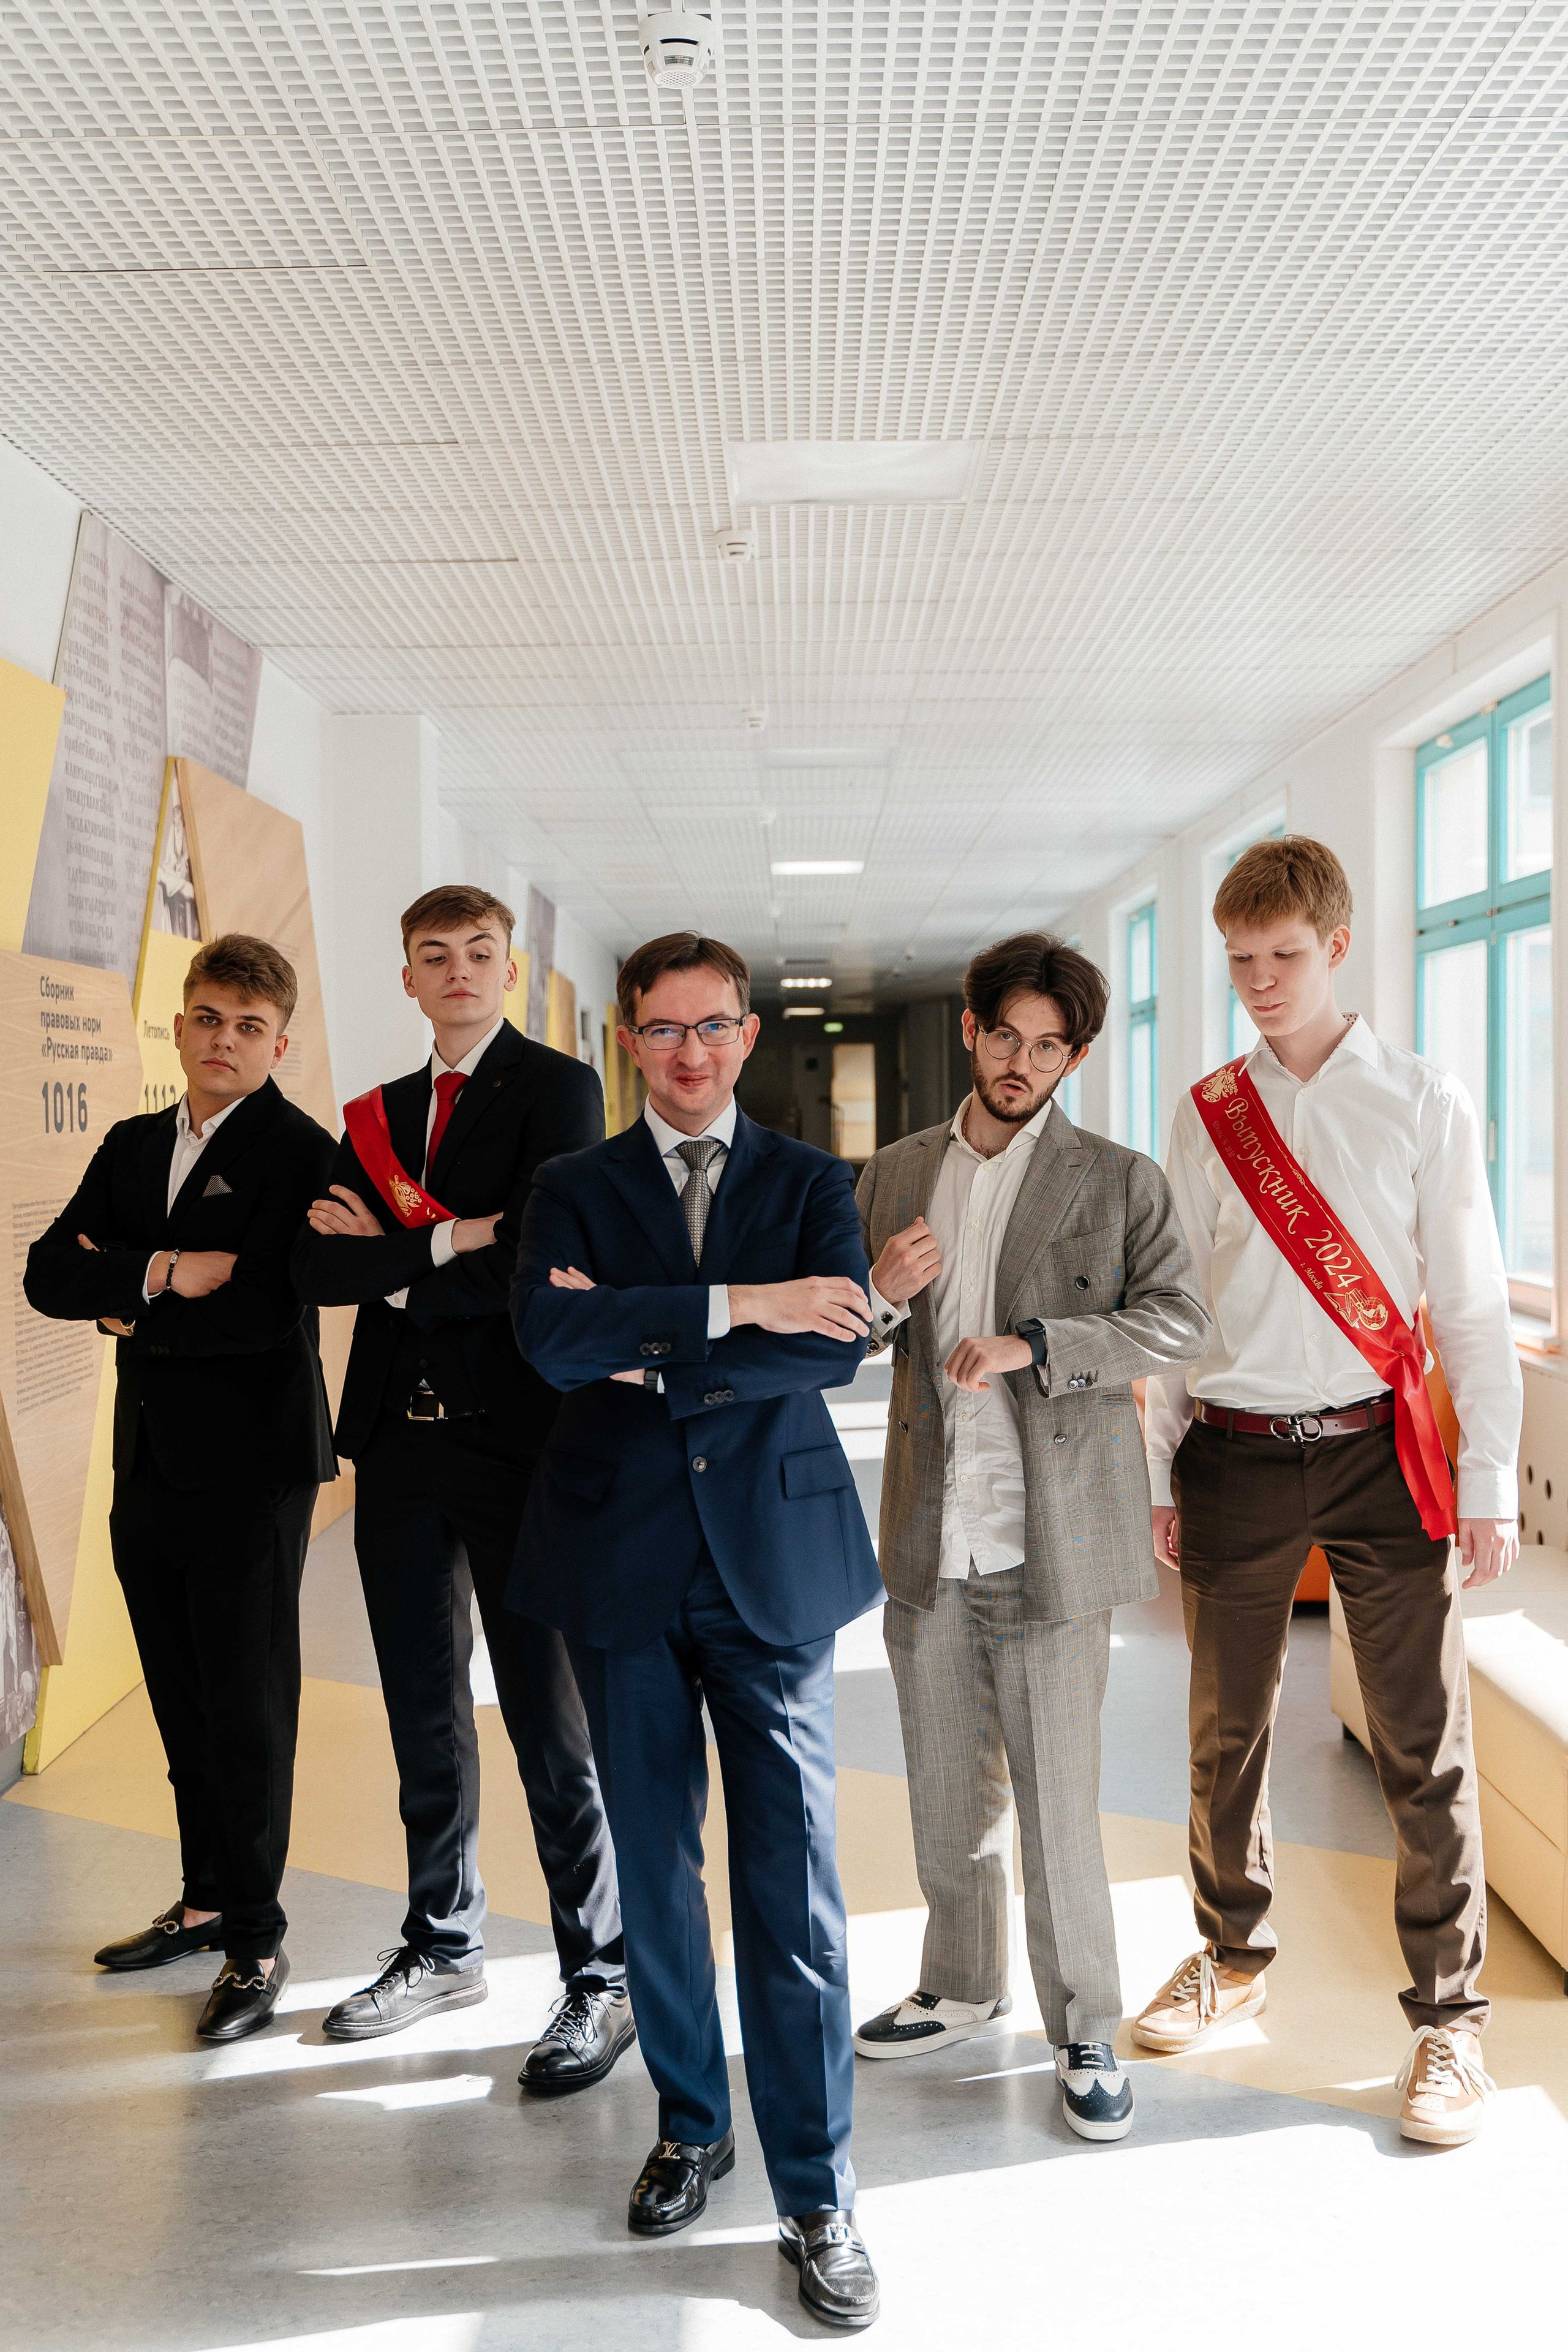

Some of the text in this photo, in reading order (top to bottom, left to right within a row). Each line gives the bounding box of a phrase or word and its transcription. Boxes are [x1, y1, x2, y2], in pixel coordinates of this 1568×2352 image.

[40, 976, 74, 1004] Сборник
[41, 1011, 101, 1037] правовых норм
[144, 1020, 170, 1040] Летопись
[42, 1037, 113, 1065] «Русская правда»
[42, 1082, 88, 1133] 1016
[1224, 1098, 1363, 1289] Выпускник 2024
[1305, 1267, 1323, 1289] Москва
